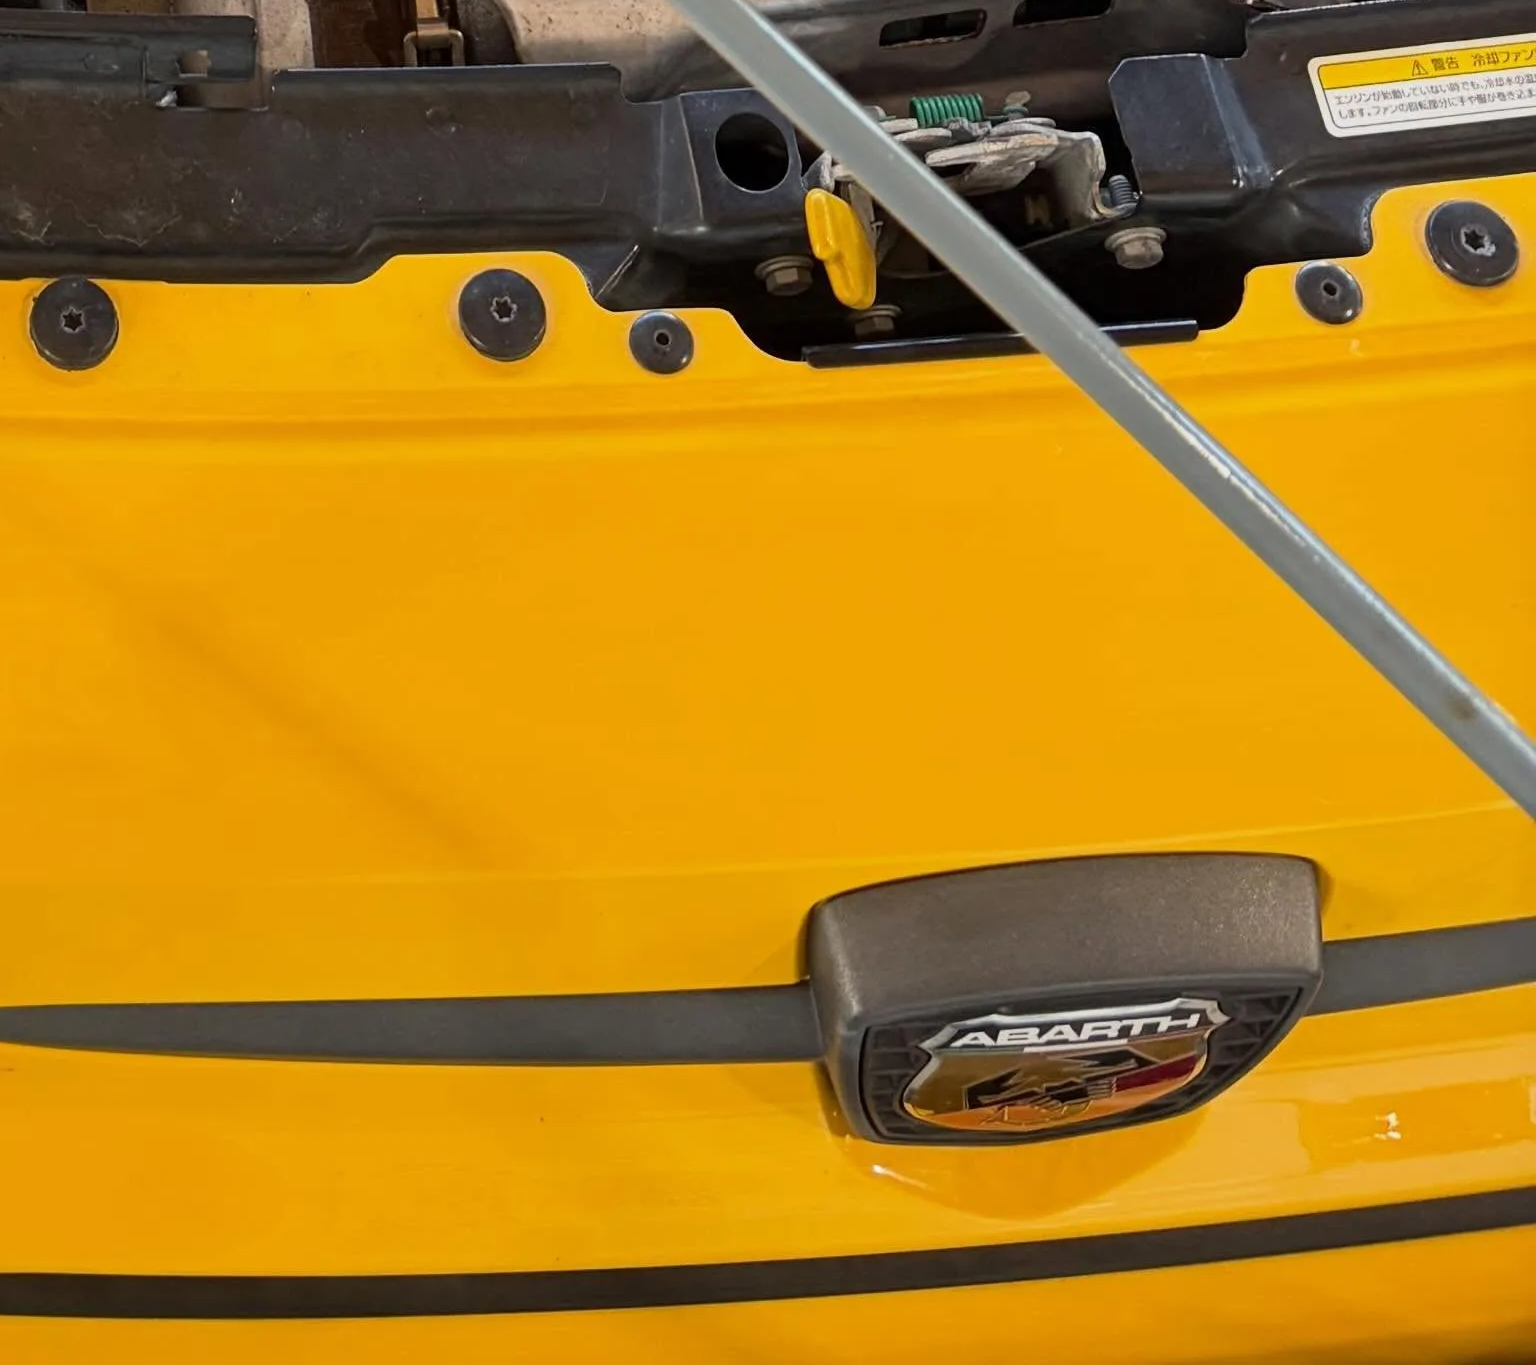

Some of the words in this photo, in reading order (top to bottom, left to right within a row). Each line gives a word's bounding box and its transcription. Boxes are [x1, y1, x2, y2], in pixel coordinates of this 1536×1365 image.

[1431, 57, 1459, 70] 警告
[1471, 48, 1536, 67] 冷却ファン
[1334, 73, 1536, 106] エンジンが始動していない時でも、冷却水の温
[950, 1013, 1200, 1048] ABARTH
